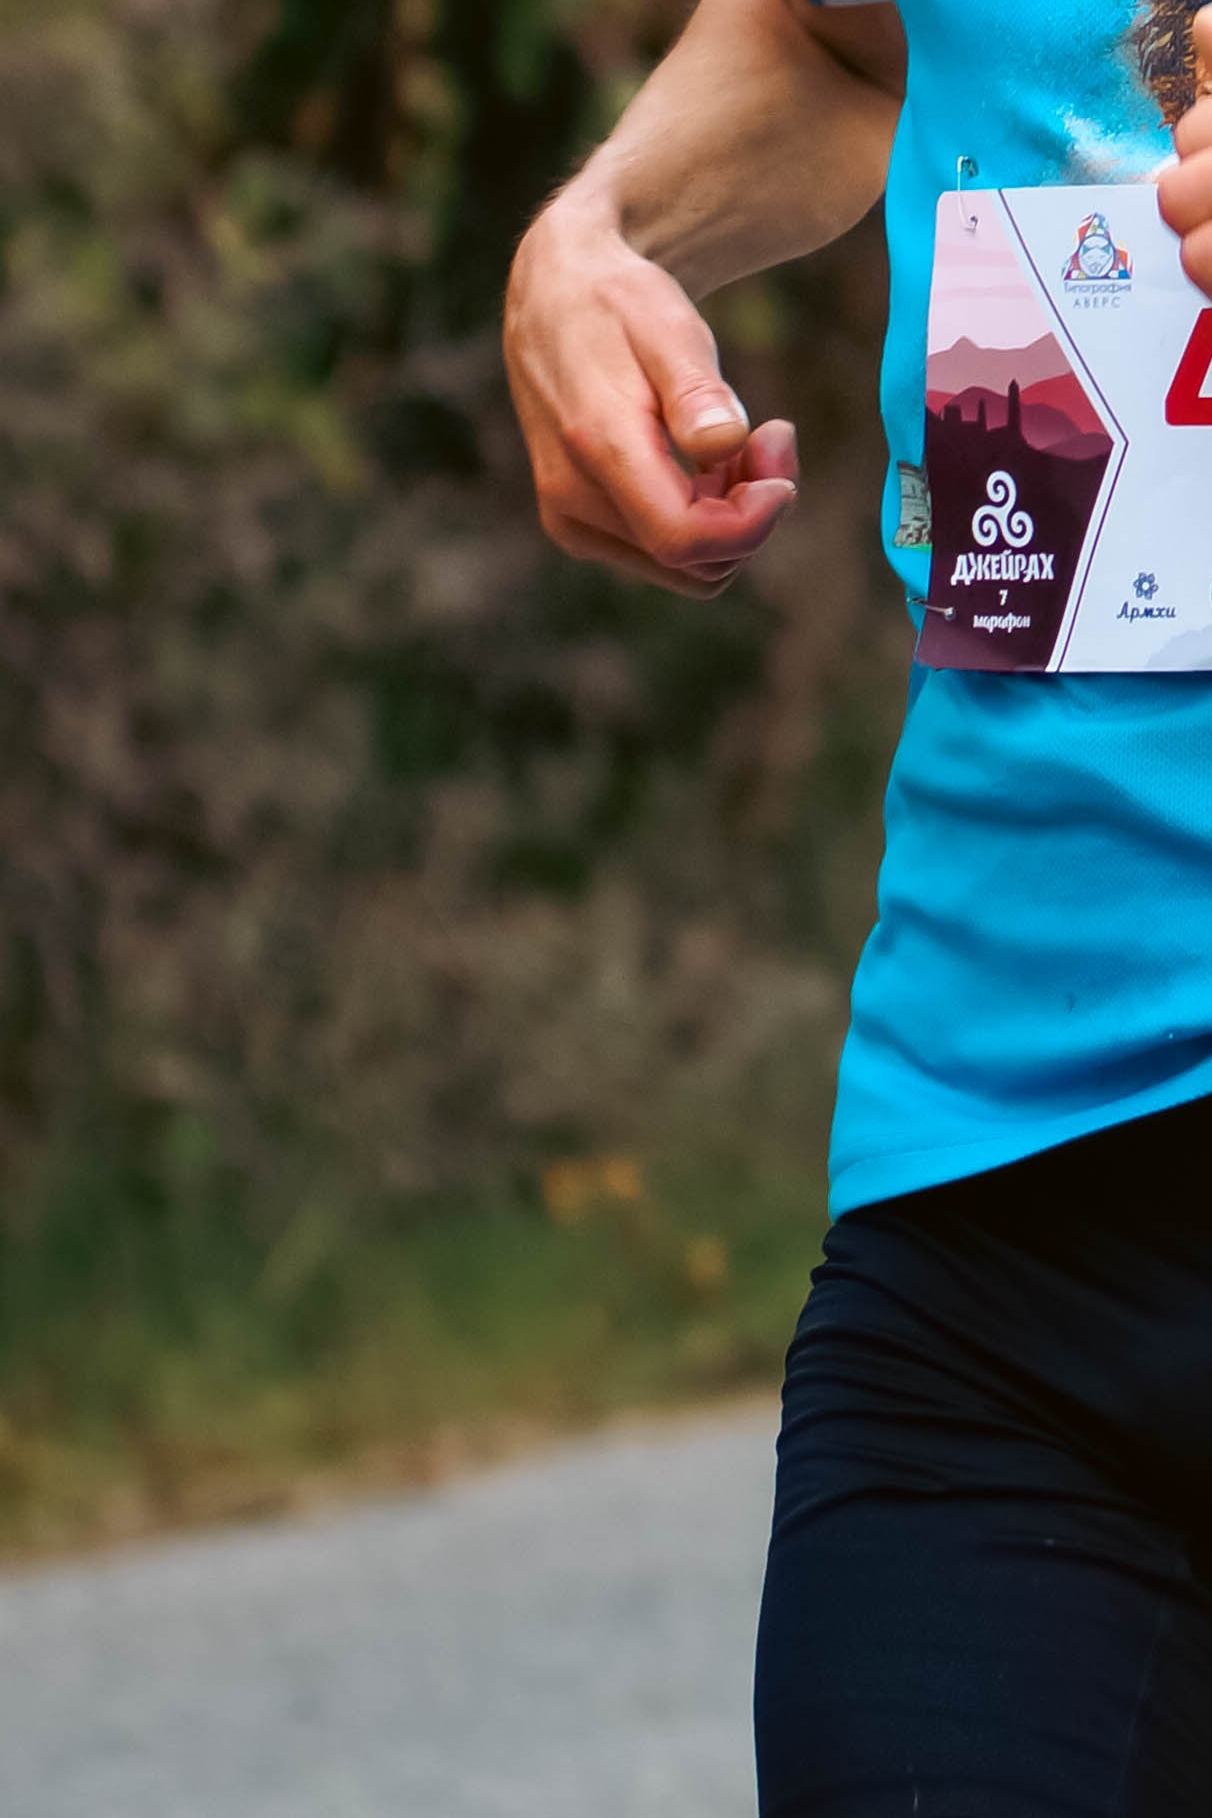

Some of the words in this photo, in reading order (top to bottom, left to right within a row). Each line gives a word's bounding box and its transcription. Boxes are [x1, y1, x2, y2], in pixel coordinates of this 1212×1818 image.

[950, 549, 1055, 586] ДЖЕЙРАХ
[999, 589, 1008, 606] 7
[973, 612, 1031, 634] марафон
[1116, 601, 1177, 624] Армхи
